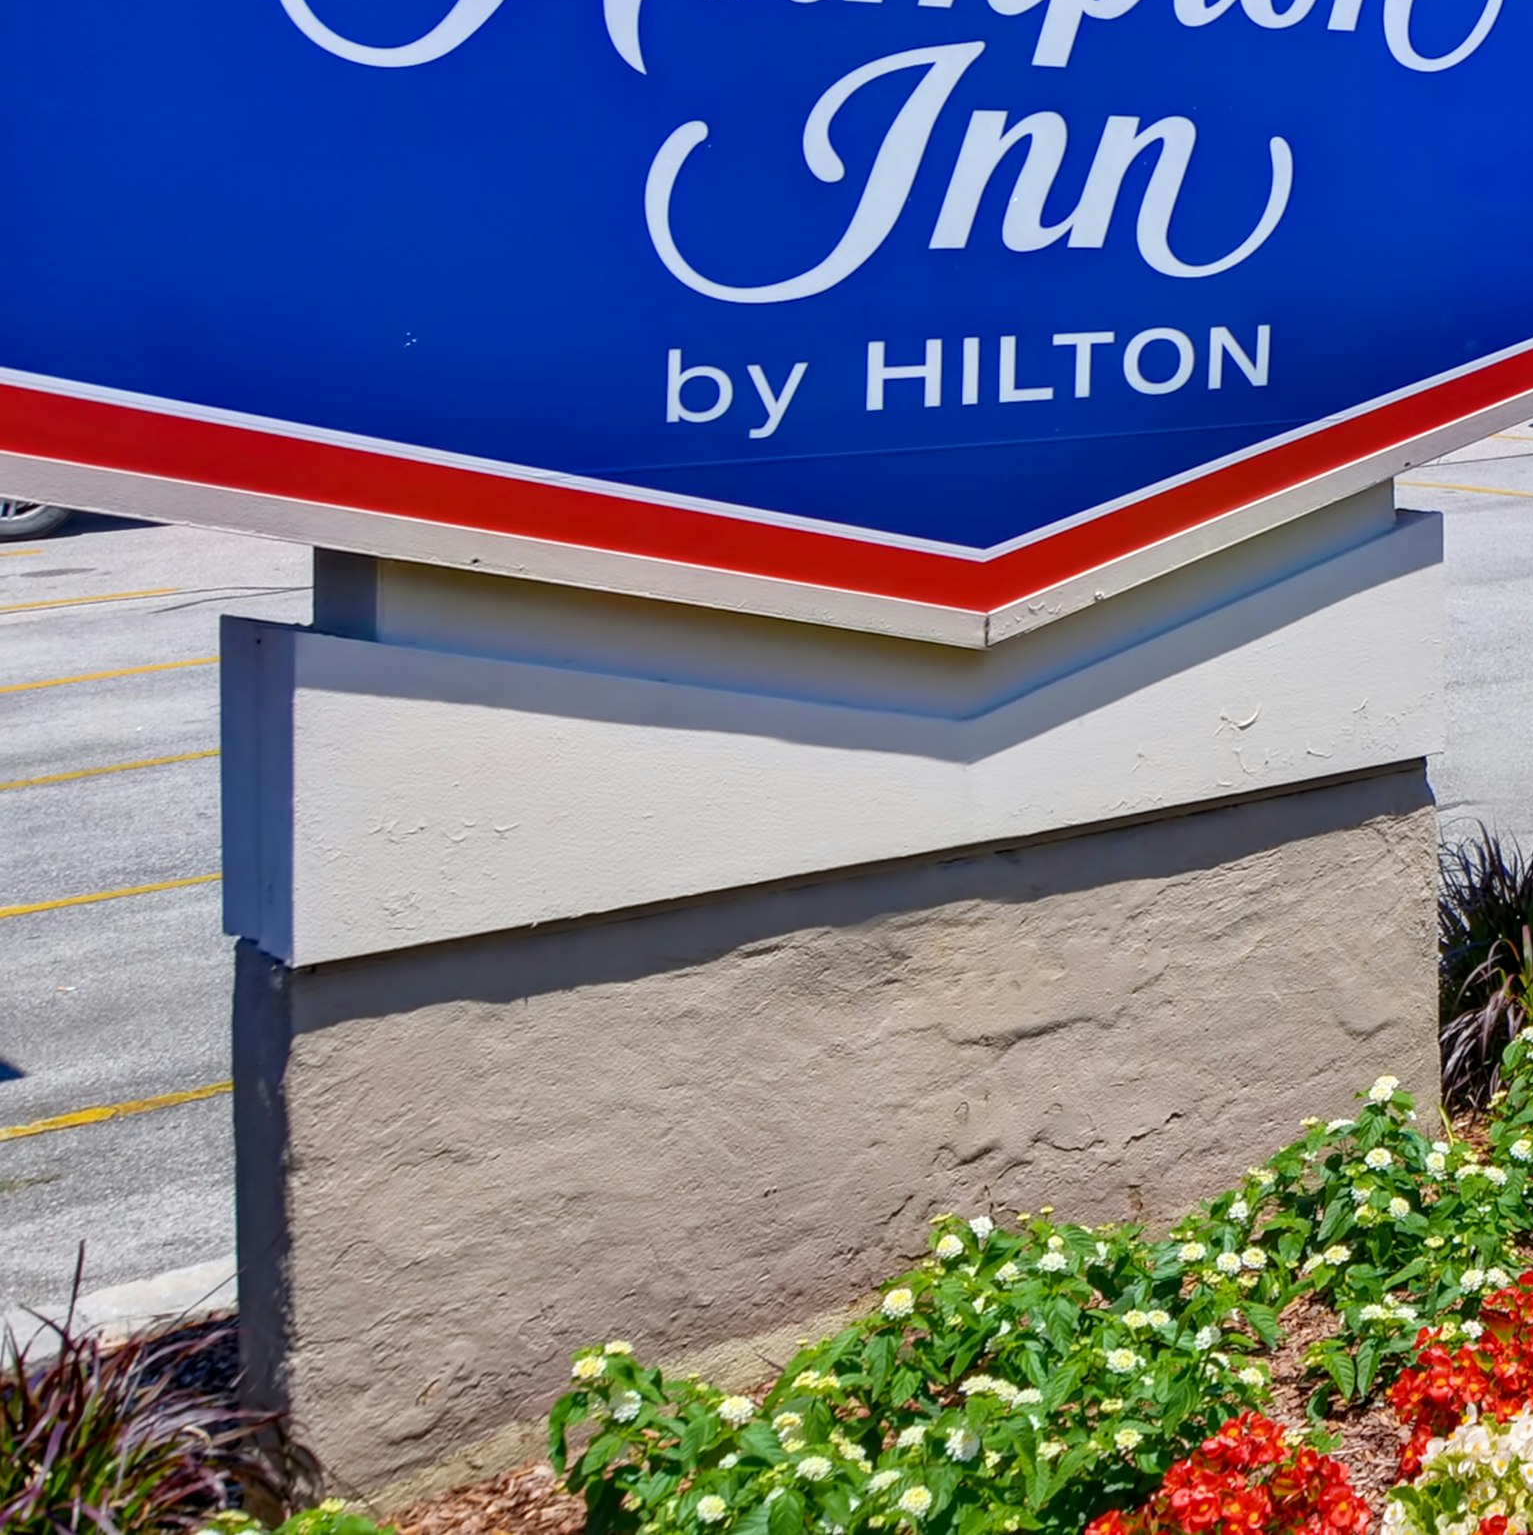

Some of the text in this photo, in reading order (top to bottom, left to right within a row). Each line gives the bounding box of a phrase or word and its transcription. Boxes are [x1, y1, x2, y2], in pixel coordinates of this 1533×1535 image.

[645, 41, 1293, 304] Inn
[667, 325, 1270, 439] by HILTON
